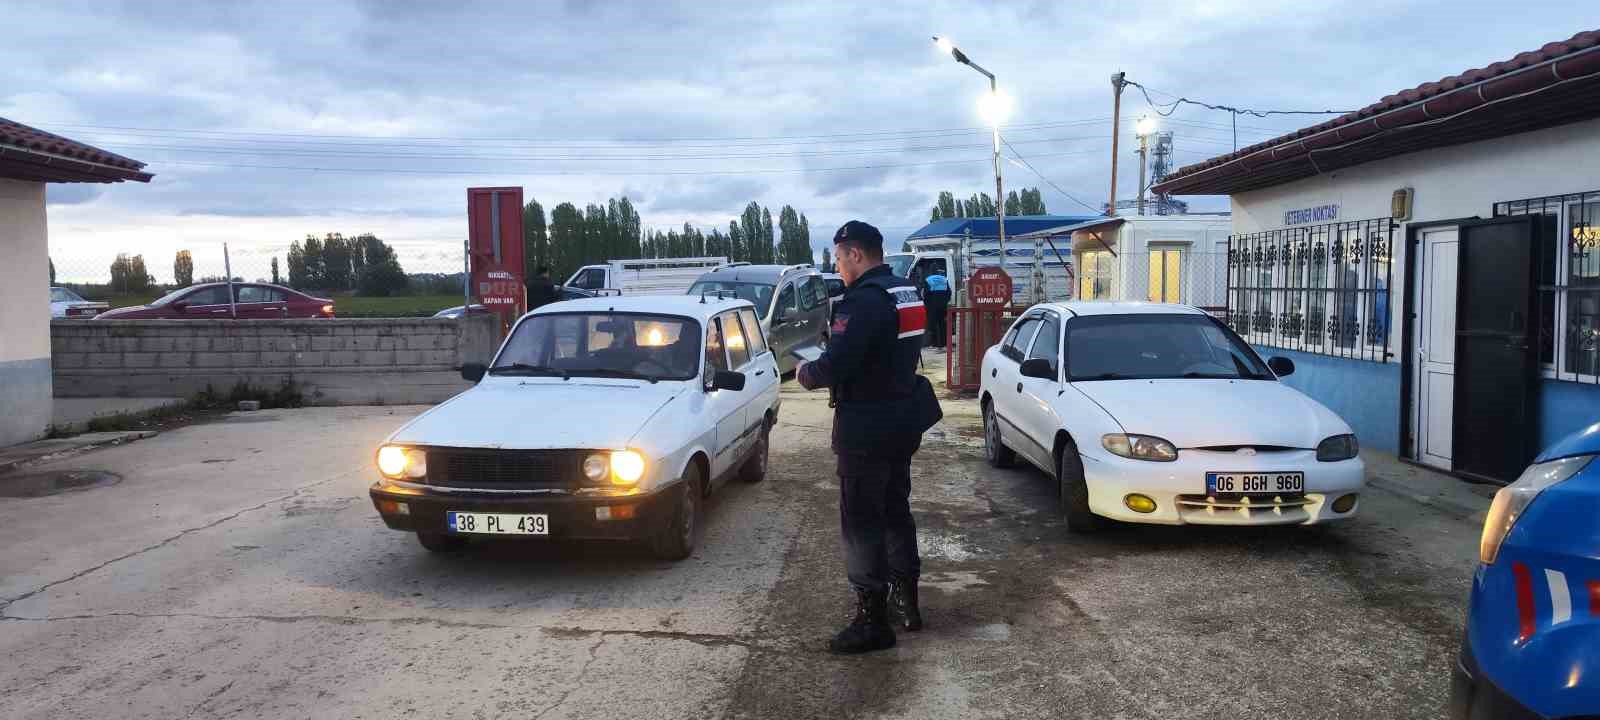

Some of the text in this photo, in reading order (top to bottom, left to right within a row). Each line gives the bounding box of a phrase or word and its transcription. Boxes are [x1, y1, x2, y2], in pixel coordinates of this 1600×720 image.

[480, 281, 520, 296] DUR
[973, 283, 1007, 297] DUR
[1217, 476, 1234, 491] 06
[1243, 475, 1268, 490] BGH
[1276, 475, 1301, 489] 960
[458, 515, 545, 532] 38 PL 439
